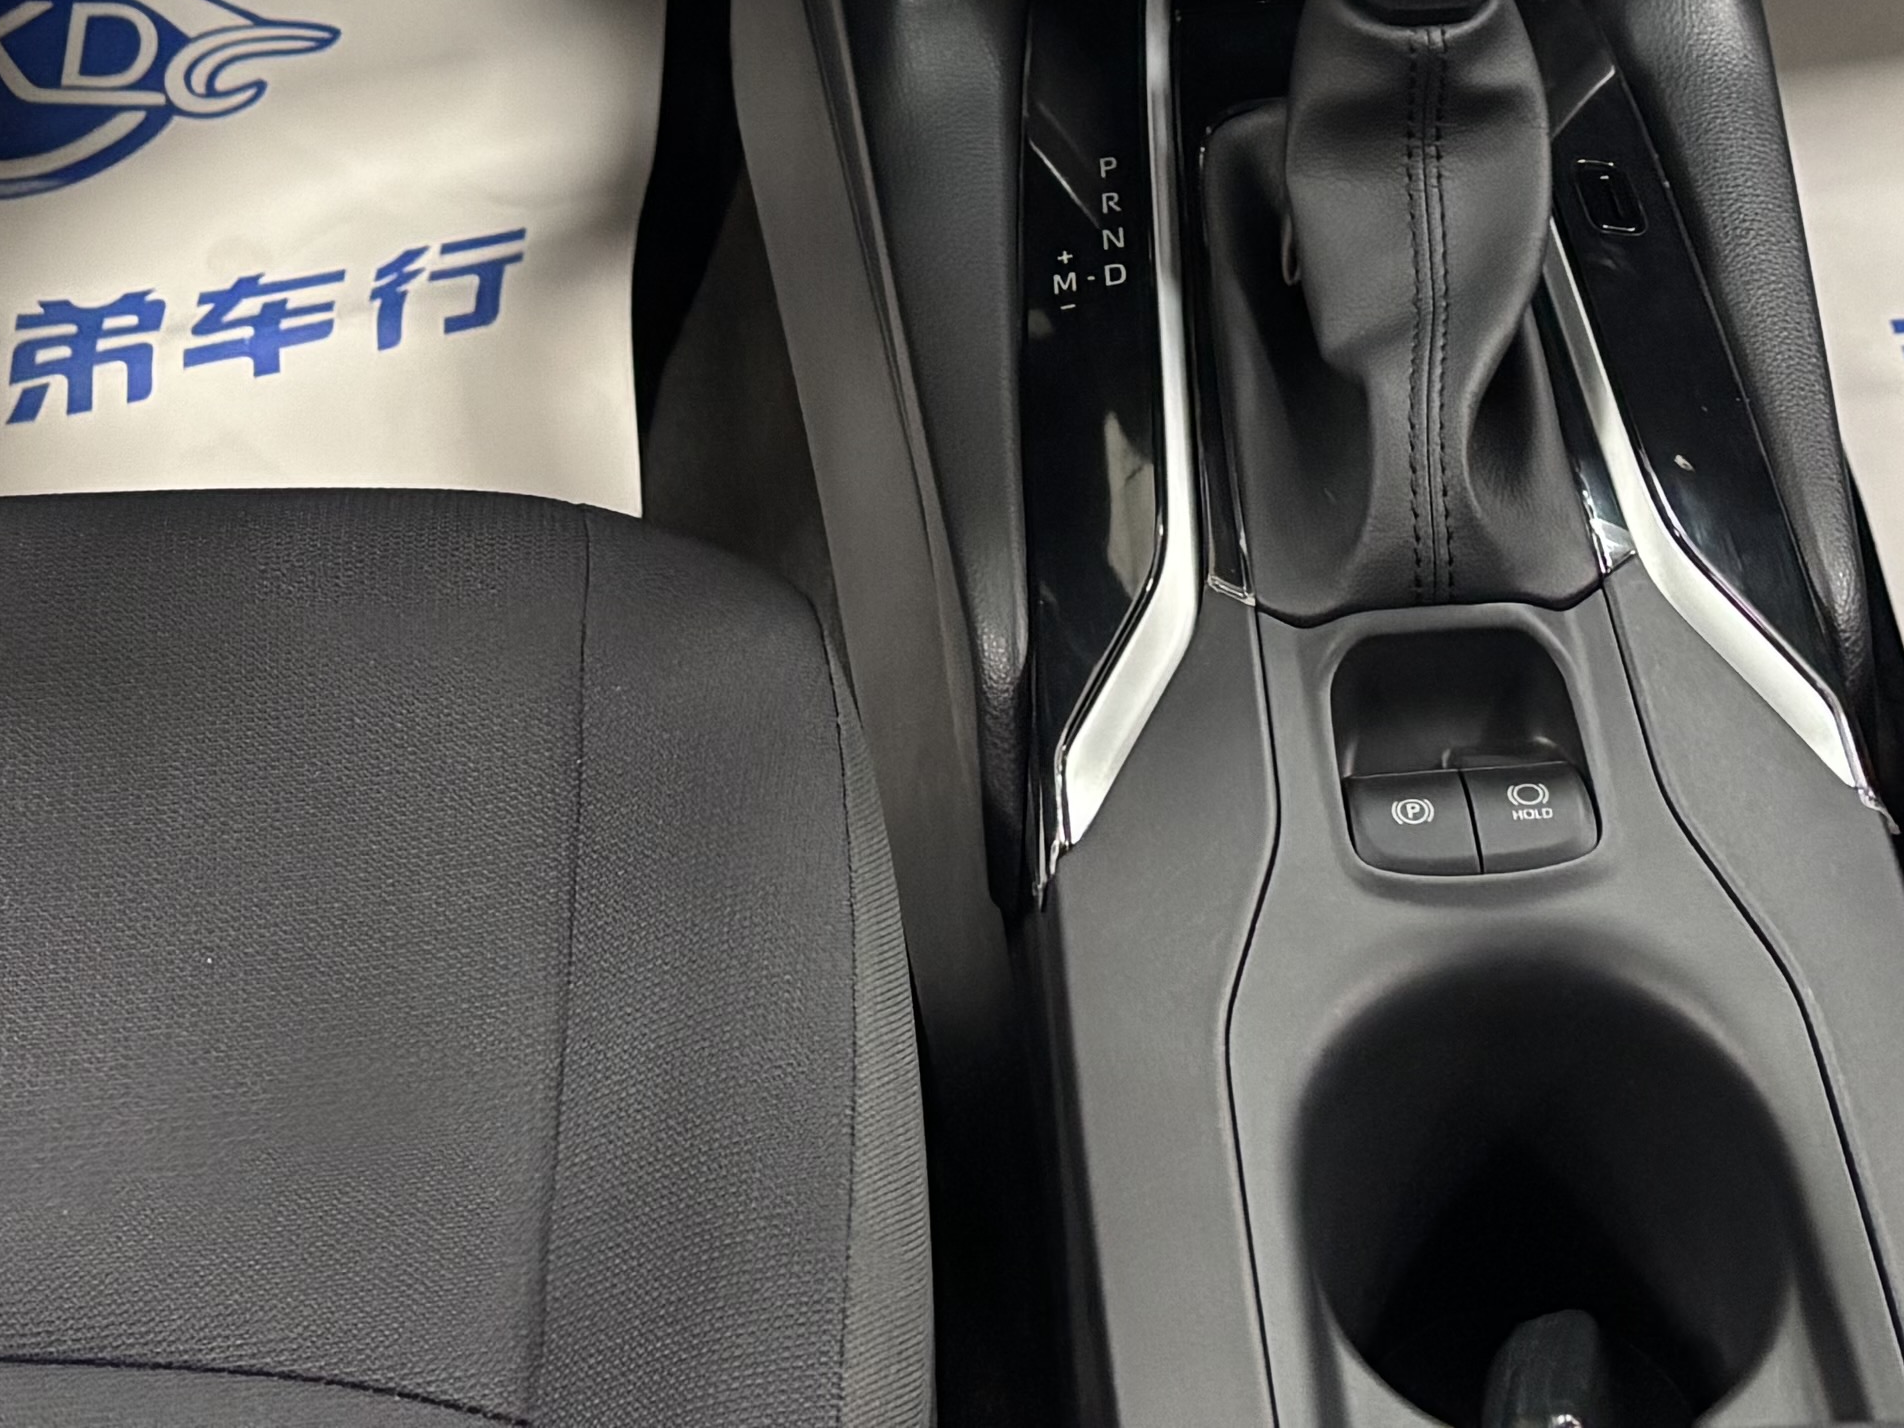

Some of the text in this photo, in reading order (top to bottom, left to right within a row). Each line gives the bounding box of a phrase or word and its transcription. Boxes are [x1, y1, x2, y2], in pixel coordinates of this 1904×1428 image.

[1099, 156, 1119, 179] P
[1101, 192, 1123, 214] R
[1101, 227, 1126, 251] N
[1052, 271, 1078, 295] M
[1104, 263, 1127, 286] D
[1511, 807, 1554, 821] HOLD
